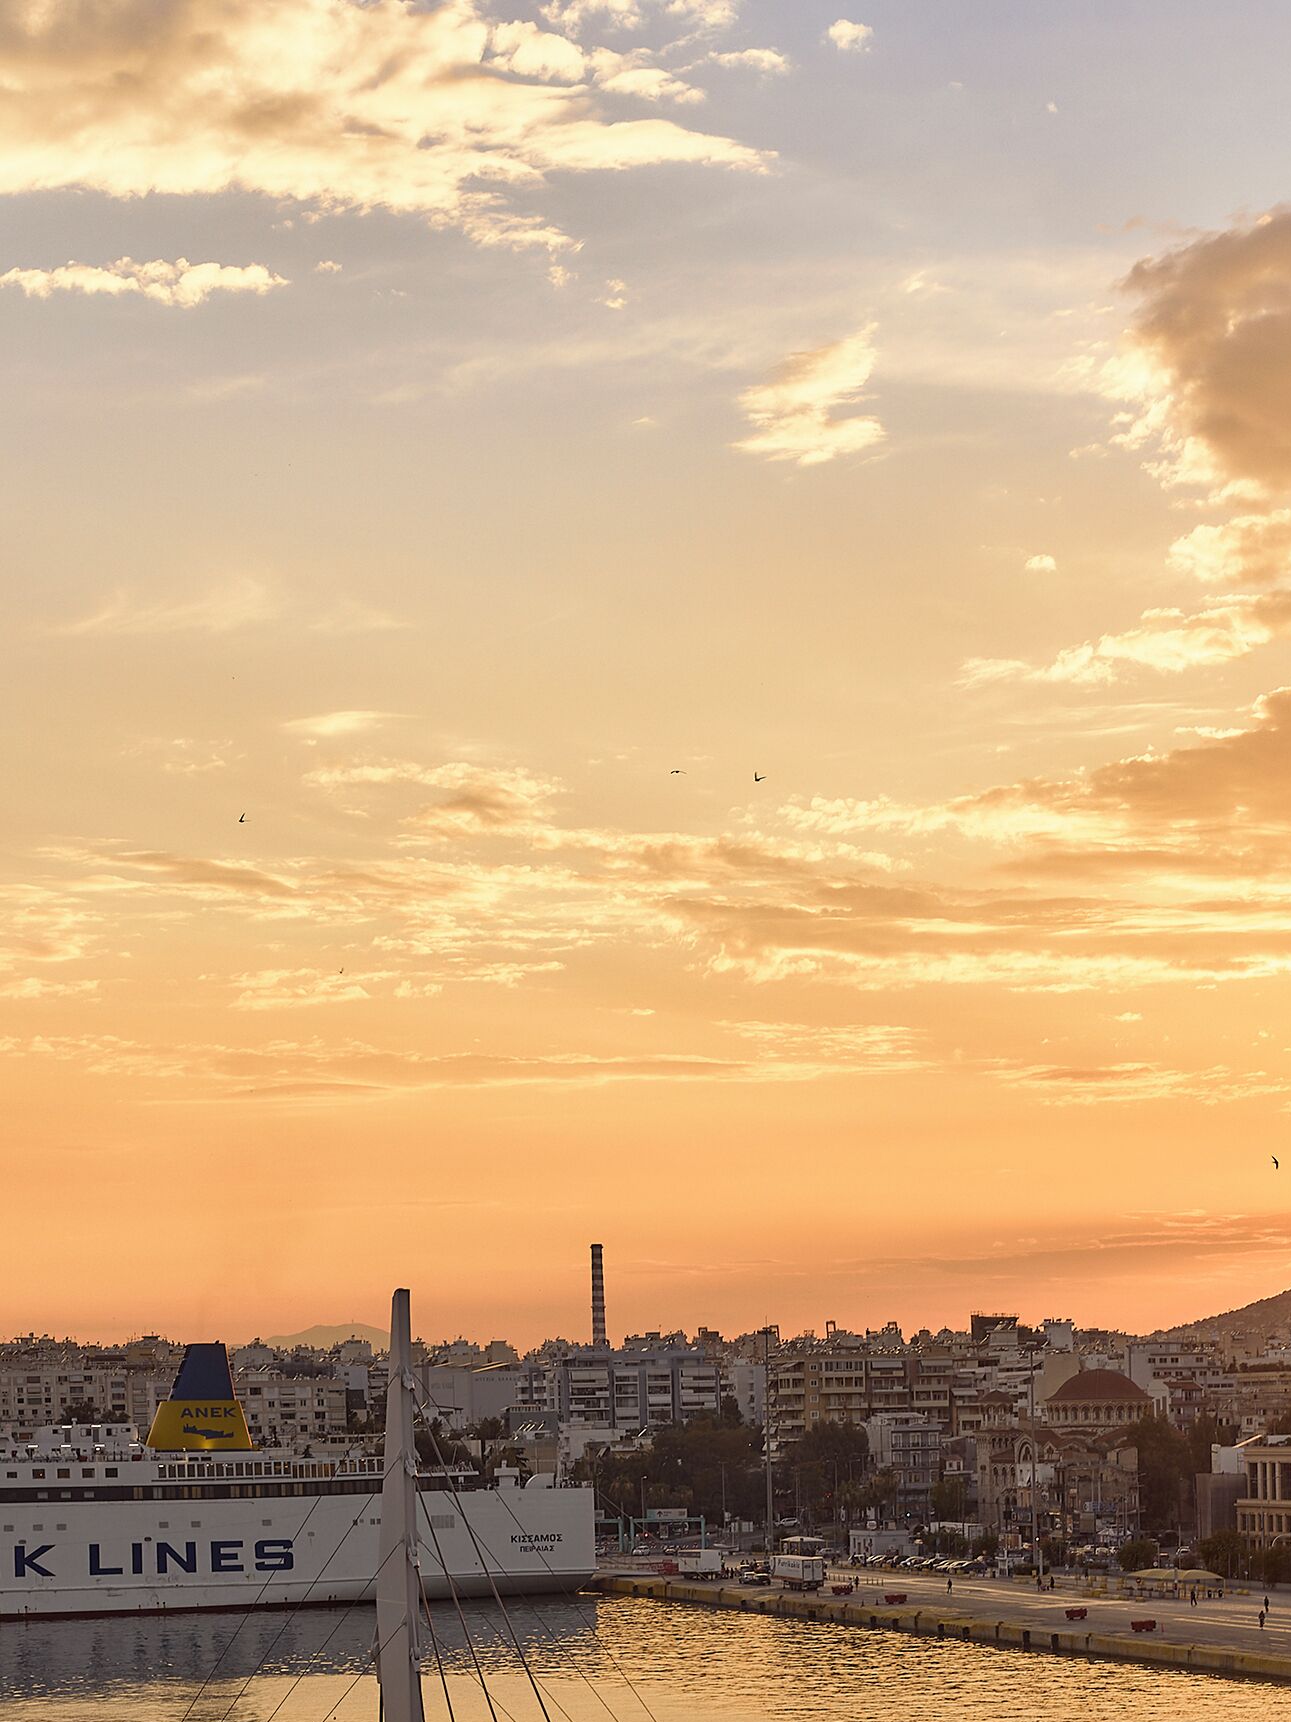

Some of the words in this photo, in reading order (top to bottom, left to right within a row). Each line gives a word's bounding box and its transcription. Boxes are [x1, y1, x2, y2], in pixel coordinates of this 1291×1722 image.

[181, 1407, 237, 1418] ANEK
[510, 1534, 563, 1543] ΚΙΣΣΑΜΟΣ
[89, 1539, 294, 1576] LINES
